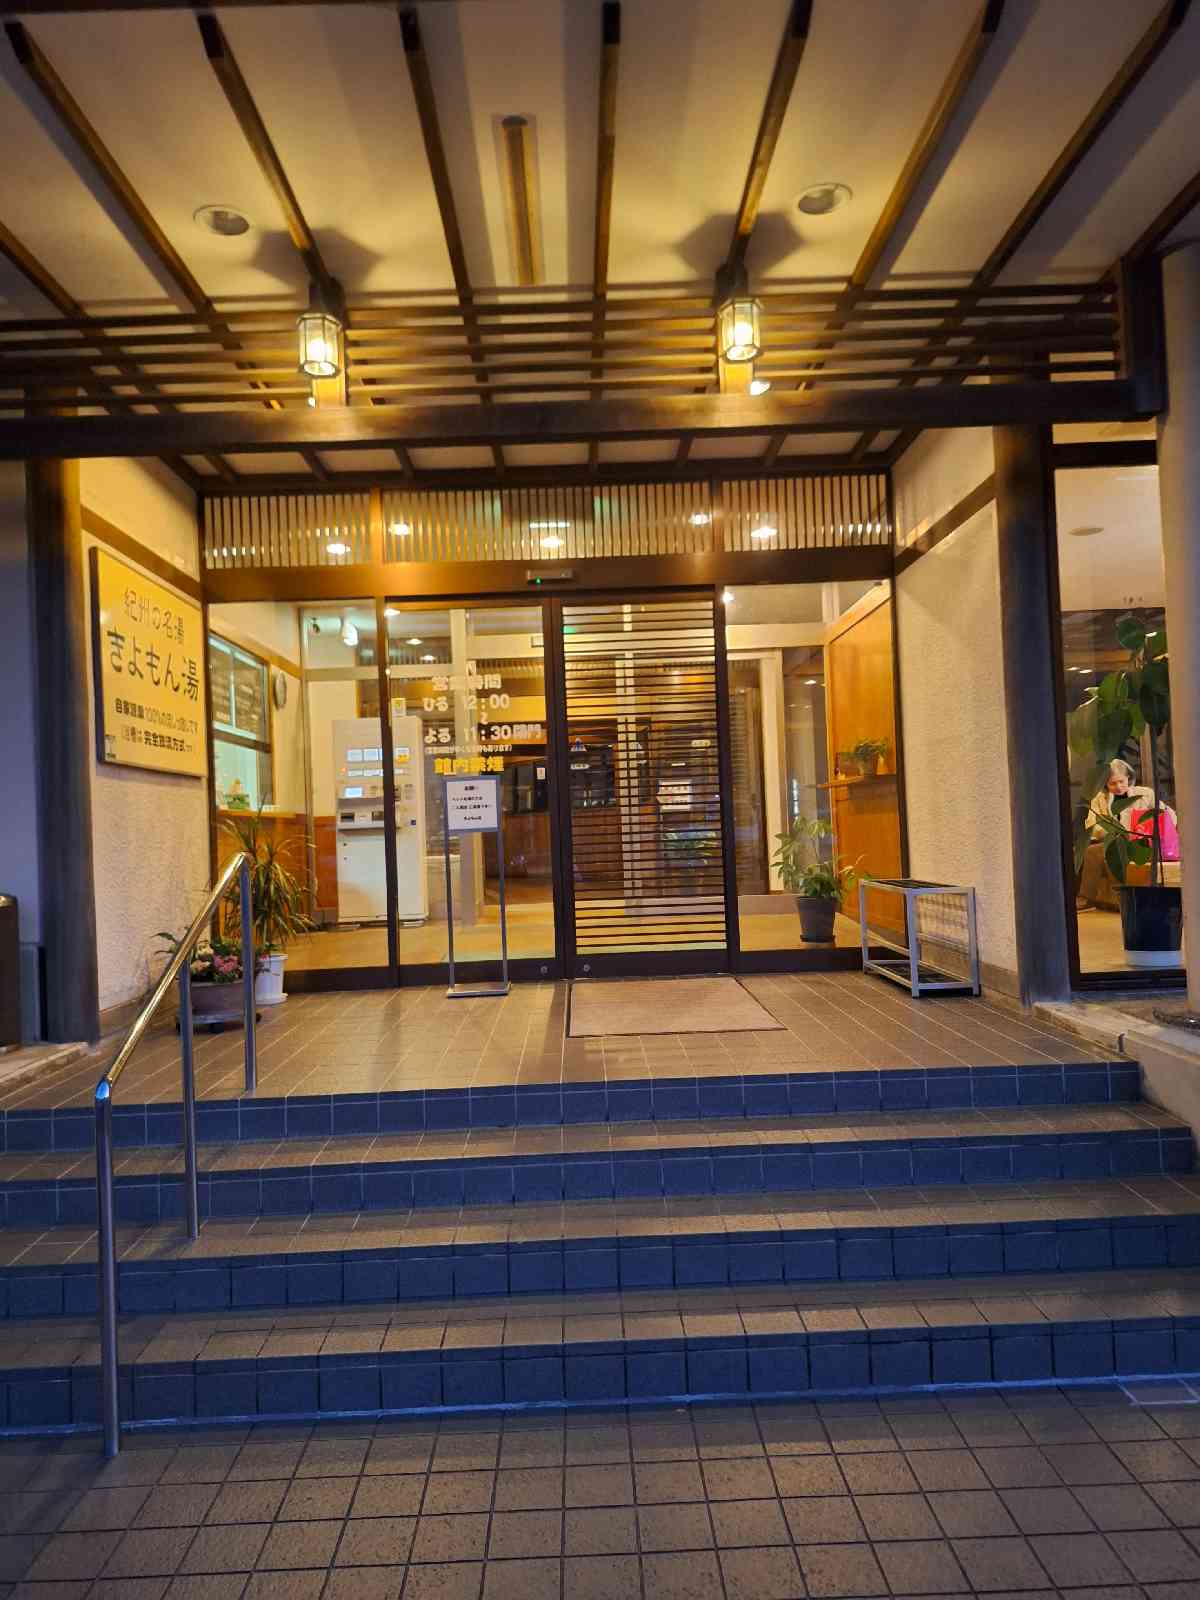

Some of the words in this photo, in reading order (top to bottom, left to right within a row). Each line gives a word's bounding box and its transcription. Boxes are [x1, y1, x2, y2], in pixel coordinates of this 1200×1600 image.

[107, 626, 199, 701] きよもん湯
[422, 697, 449, 712] ひる
[424, 727, 451, 744] よる
